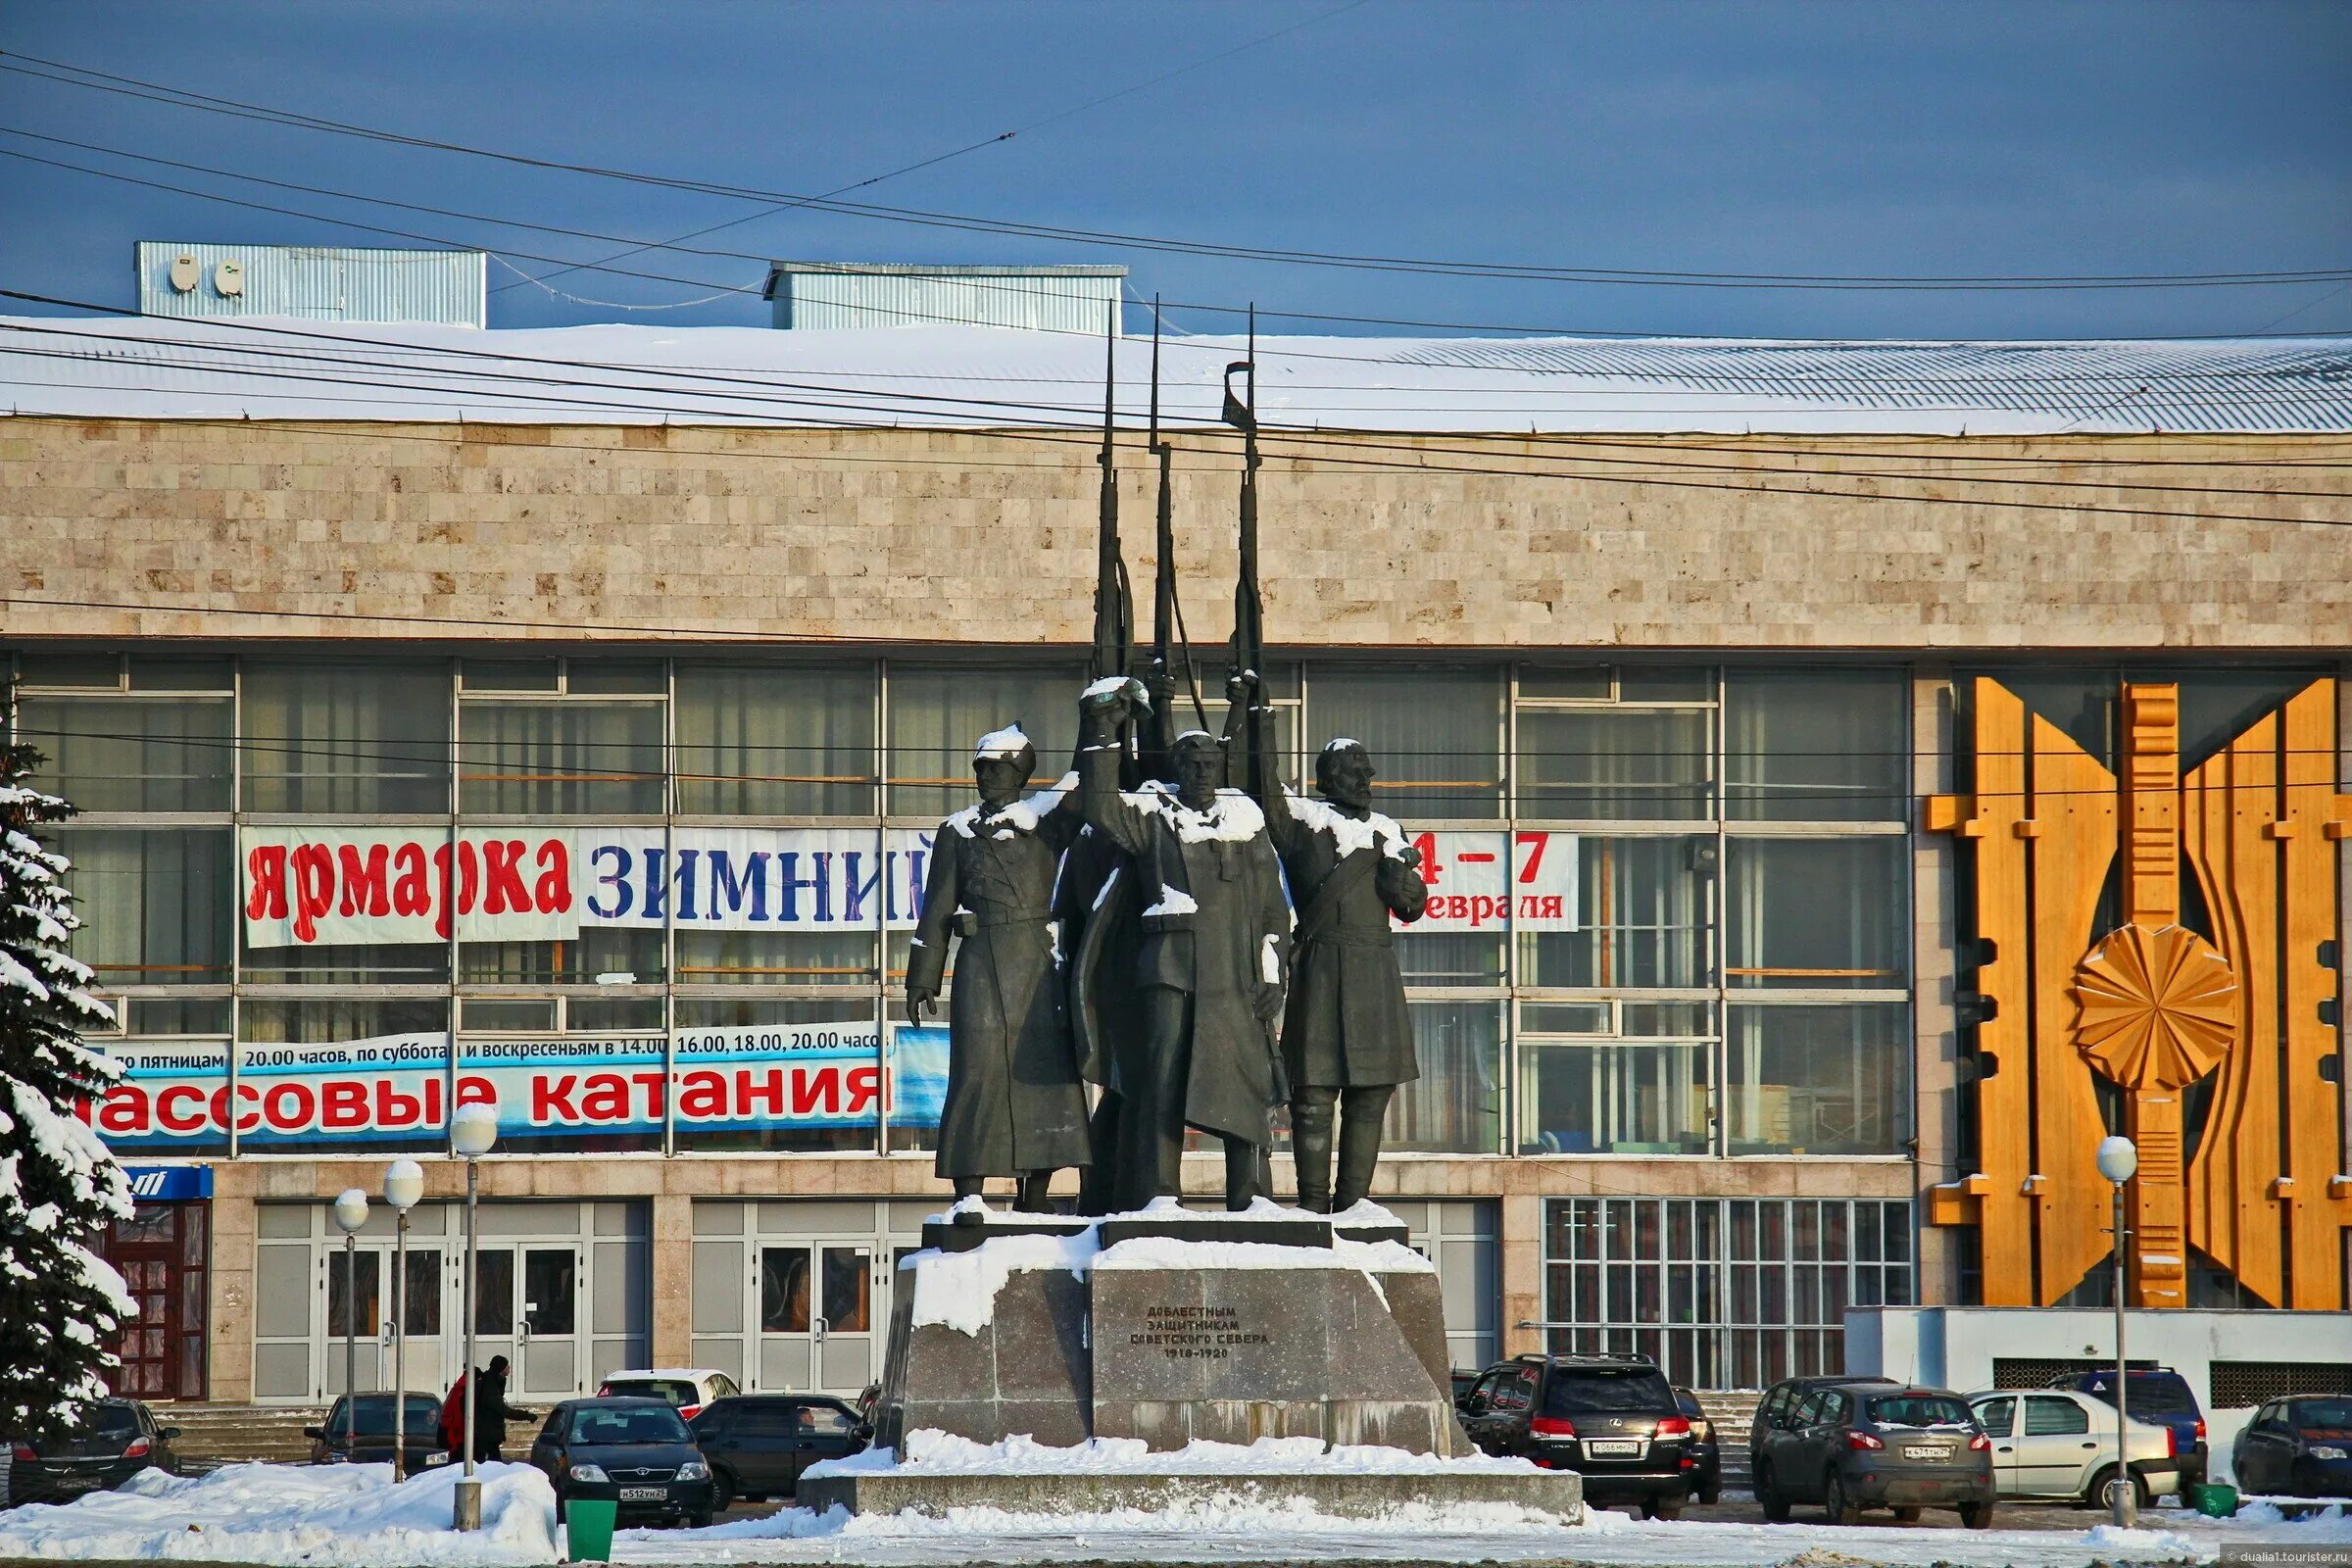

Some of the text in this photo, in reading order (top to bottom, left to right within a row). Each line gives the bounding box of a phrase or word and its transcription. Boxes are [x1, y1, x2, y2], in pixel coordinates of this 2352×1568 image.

[1515, 831, 1549, 883] 7
[245, 838, 572, 943] ярмарка
[1390, 894, 1563, 926] евраля
[140, 1054, 224, 1070] пятницам
[245, 1050, 294, 1067] 20.00
[299, 1049, 352, 1065] часов,
[357, 1047, 377, 1062] по
[466, 1045, 477, 1057] и
[482, 1041, 600, 1060] воскресеньям
[605, 1042, 614, 1055] в
[677, 1035, 730, 1054] 16.00,
[734, 1033, 787, 1054] 18.00,
[791, 1031, 838, 1050] 20.00
[843, 1033, 889, 1049] часо
[532, 1066, 891, 1121] катания
[1147, 1306, 1236, 1317] ДОБЛЕСТНЫМ
[1147, 1320, 1240, 1332] ЗАЩИТНИКАМ
[1130, 1334, 1269, 1345] СОВЕТСКОГО СЕВЕРА
